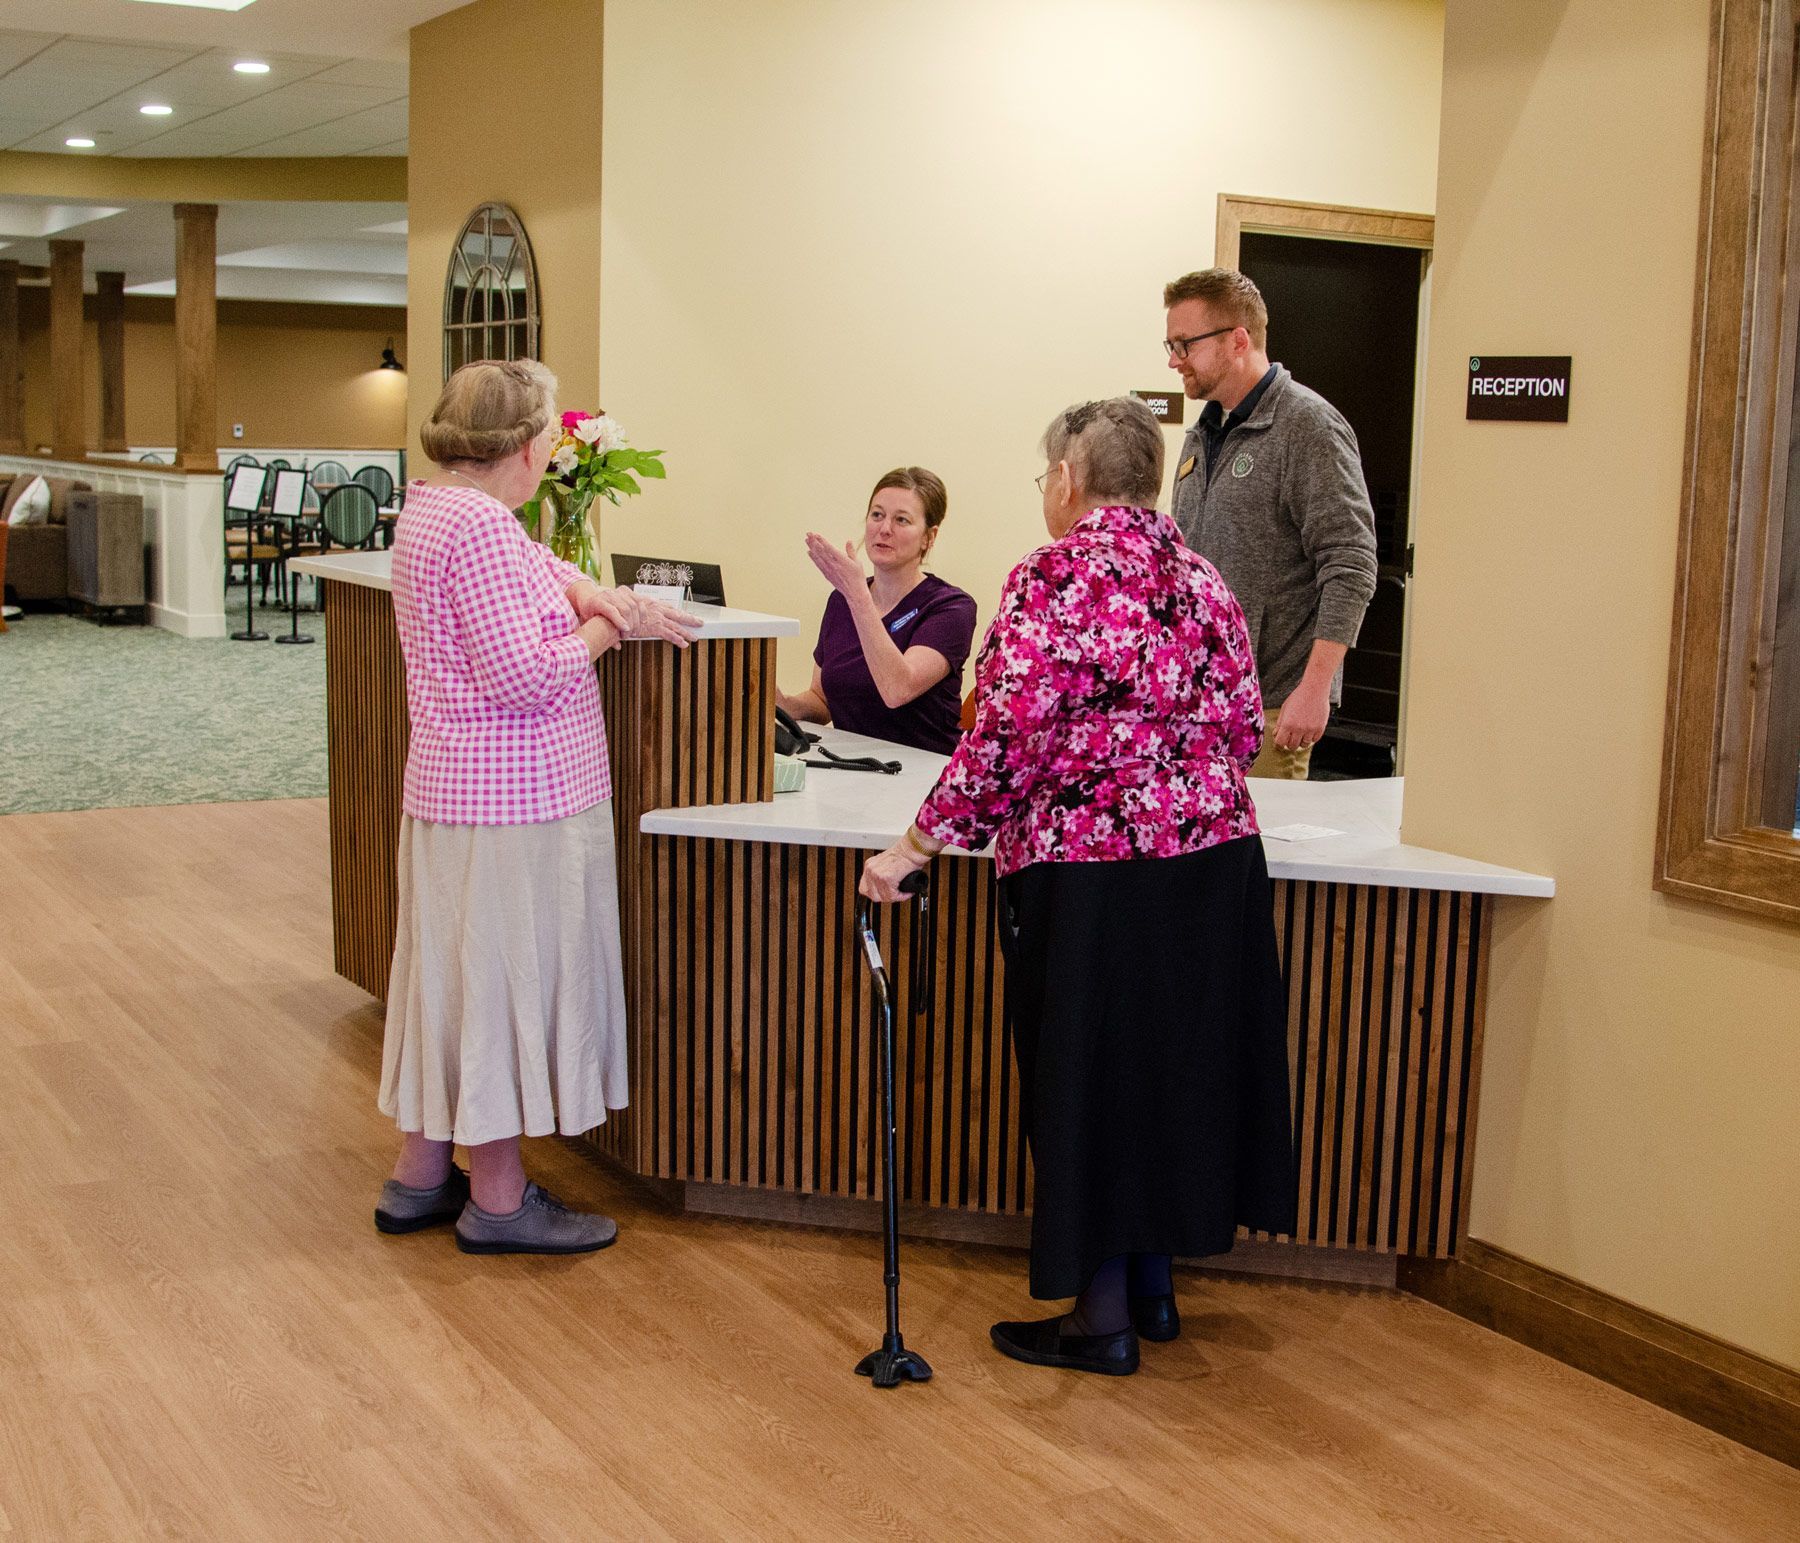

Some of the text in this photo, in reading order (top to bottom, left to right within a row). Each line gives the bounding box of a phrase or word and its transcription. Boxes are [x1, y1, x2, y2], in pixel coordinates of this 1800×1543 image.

[1471, 377, 1565, 397] RECEPTION
[1147, 399, 1168, 407] WORK
[1150, 407, 1168, 415] OOM
